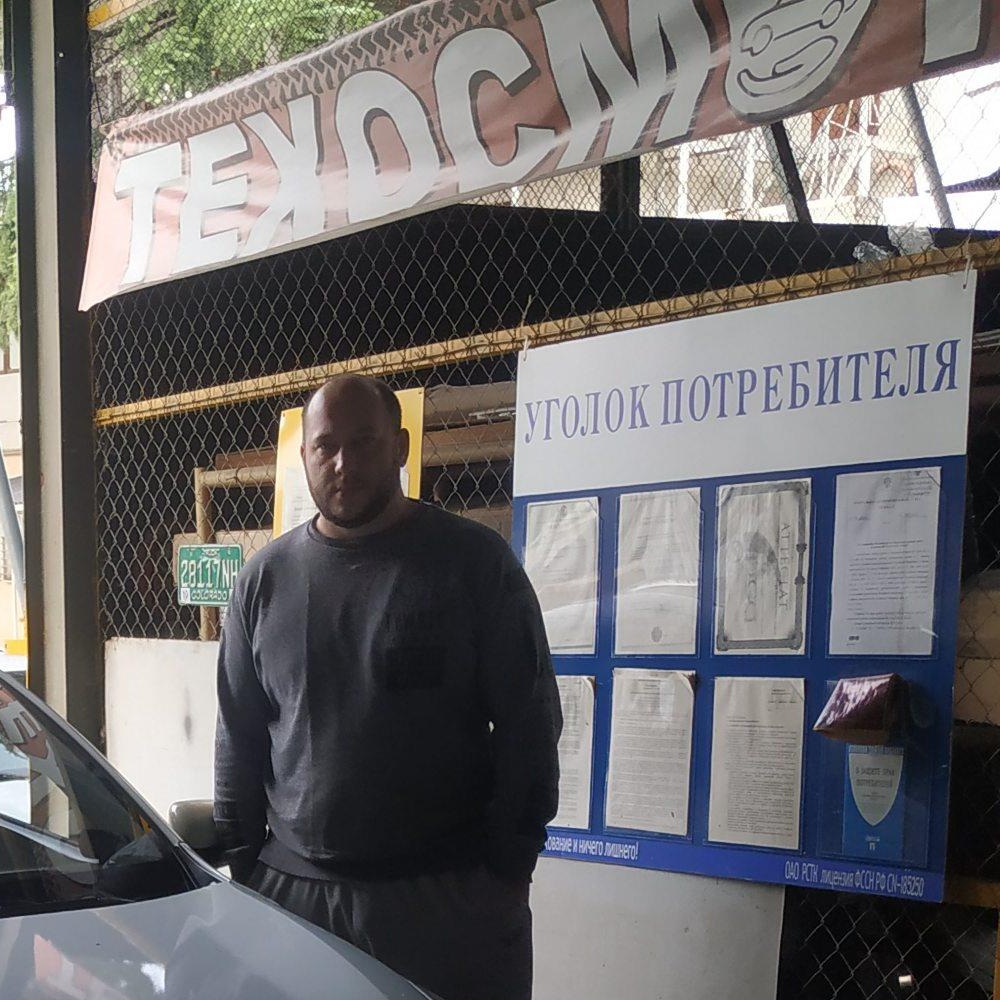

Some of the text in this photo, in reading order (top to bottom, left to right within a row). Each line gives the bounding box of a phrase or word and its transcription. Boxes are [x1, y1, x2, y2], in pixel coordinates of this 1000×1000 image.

[524, 337, 962, 444] УГОЛОК ПОТРЕБИТЕЛЯ
[573, 839, 578, 853] и
[579, 841, 602, 855] ничего
[604, 843, 639, 860] лишнего!
[785, 861, 800, 881] ОАО
[820, 869, 854, 889] лицензия
